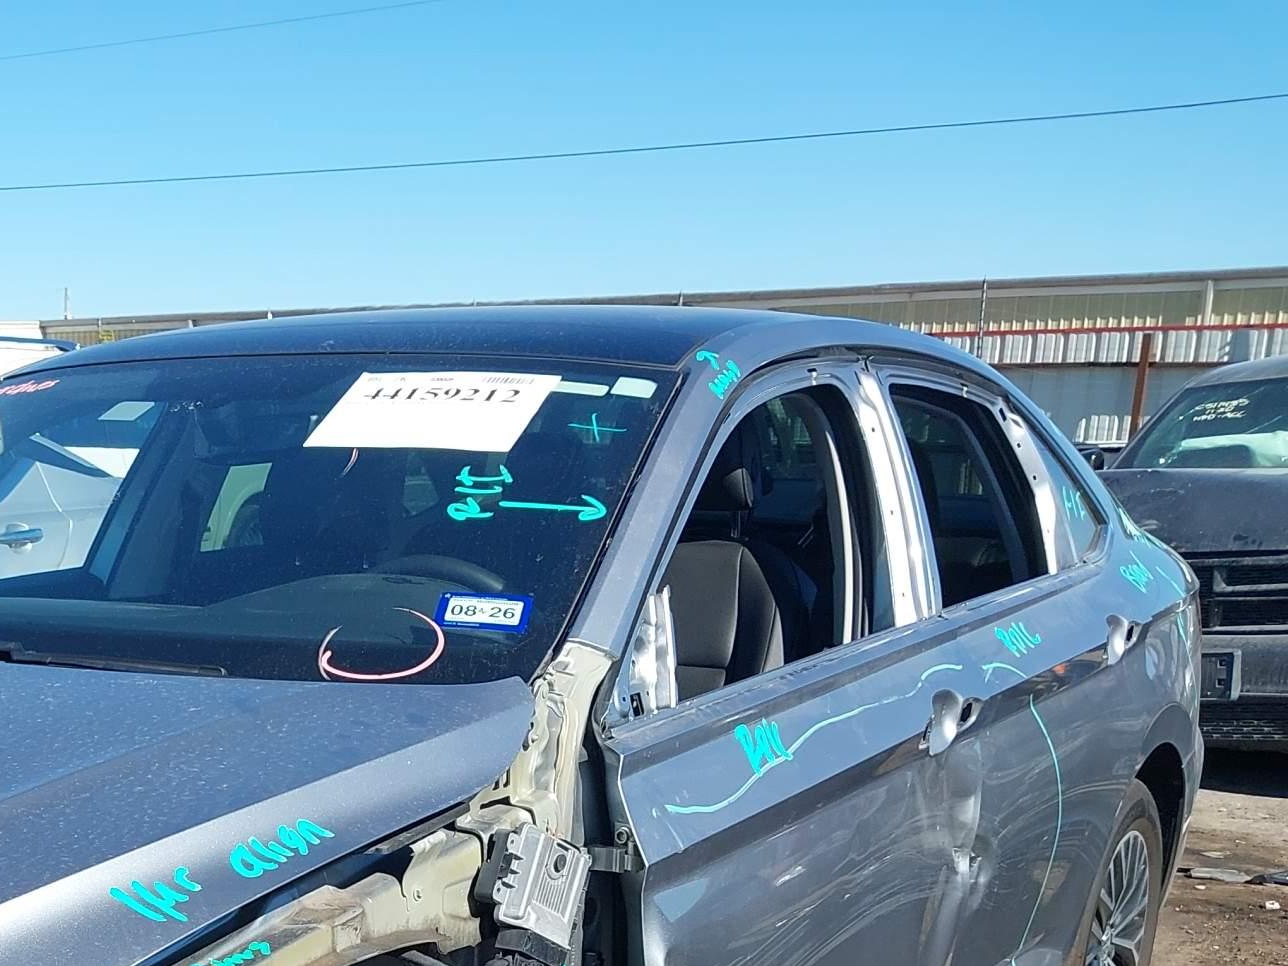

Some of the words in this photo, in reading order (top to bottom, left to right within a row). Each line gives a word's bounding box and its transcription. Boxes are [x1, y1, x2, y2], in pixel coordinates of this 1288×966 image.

[363, 387, 521, 403] 44159212
[451, 604, 477, 617] 08
[488, 606, 516, 619] 26
[229, 818, 335, 878] align
